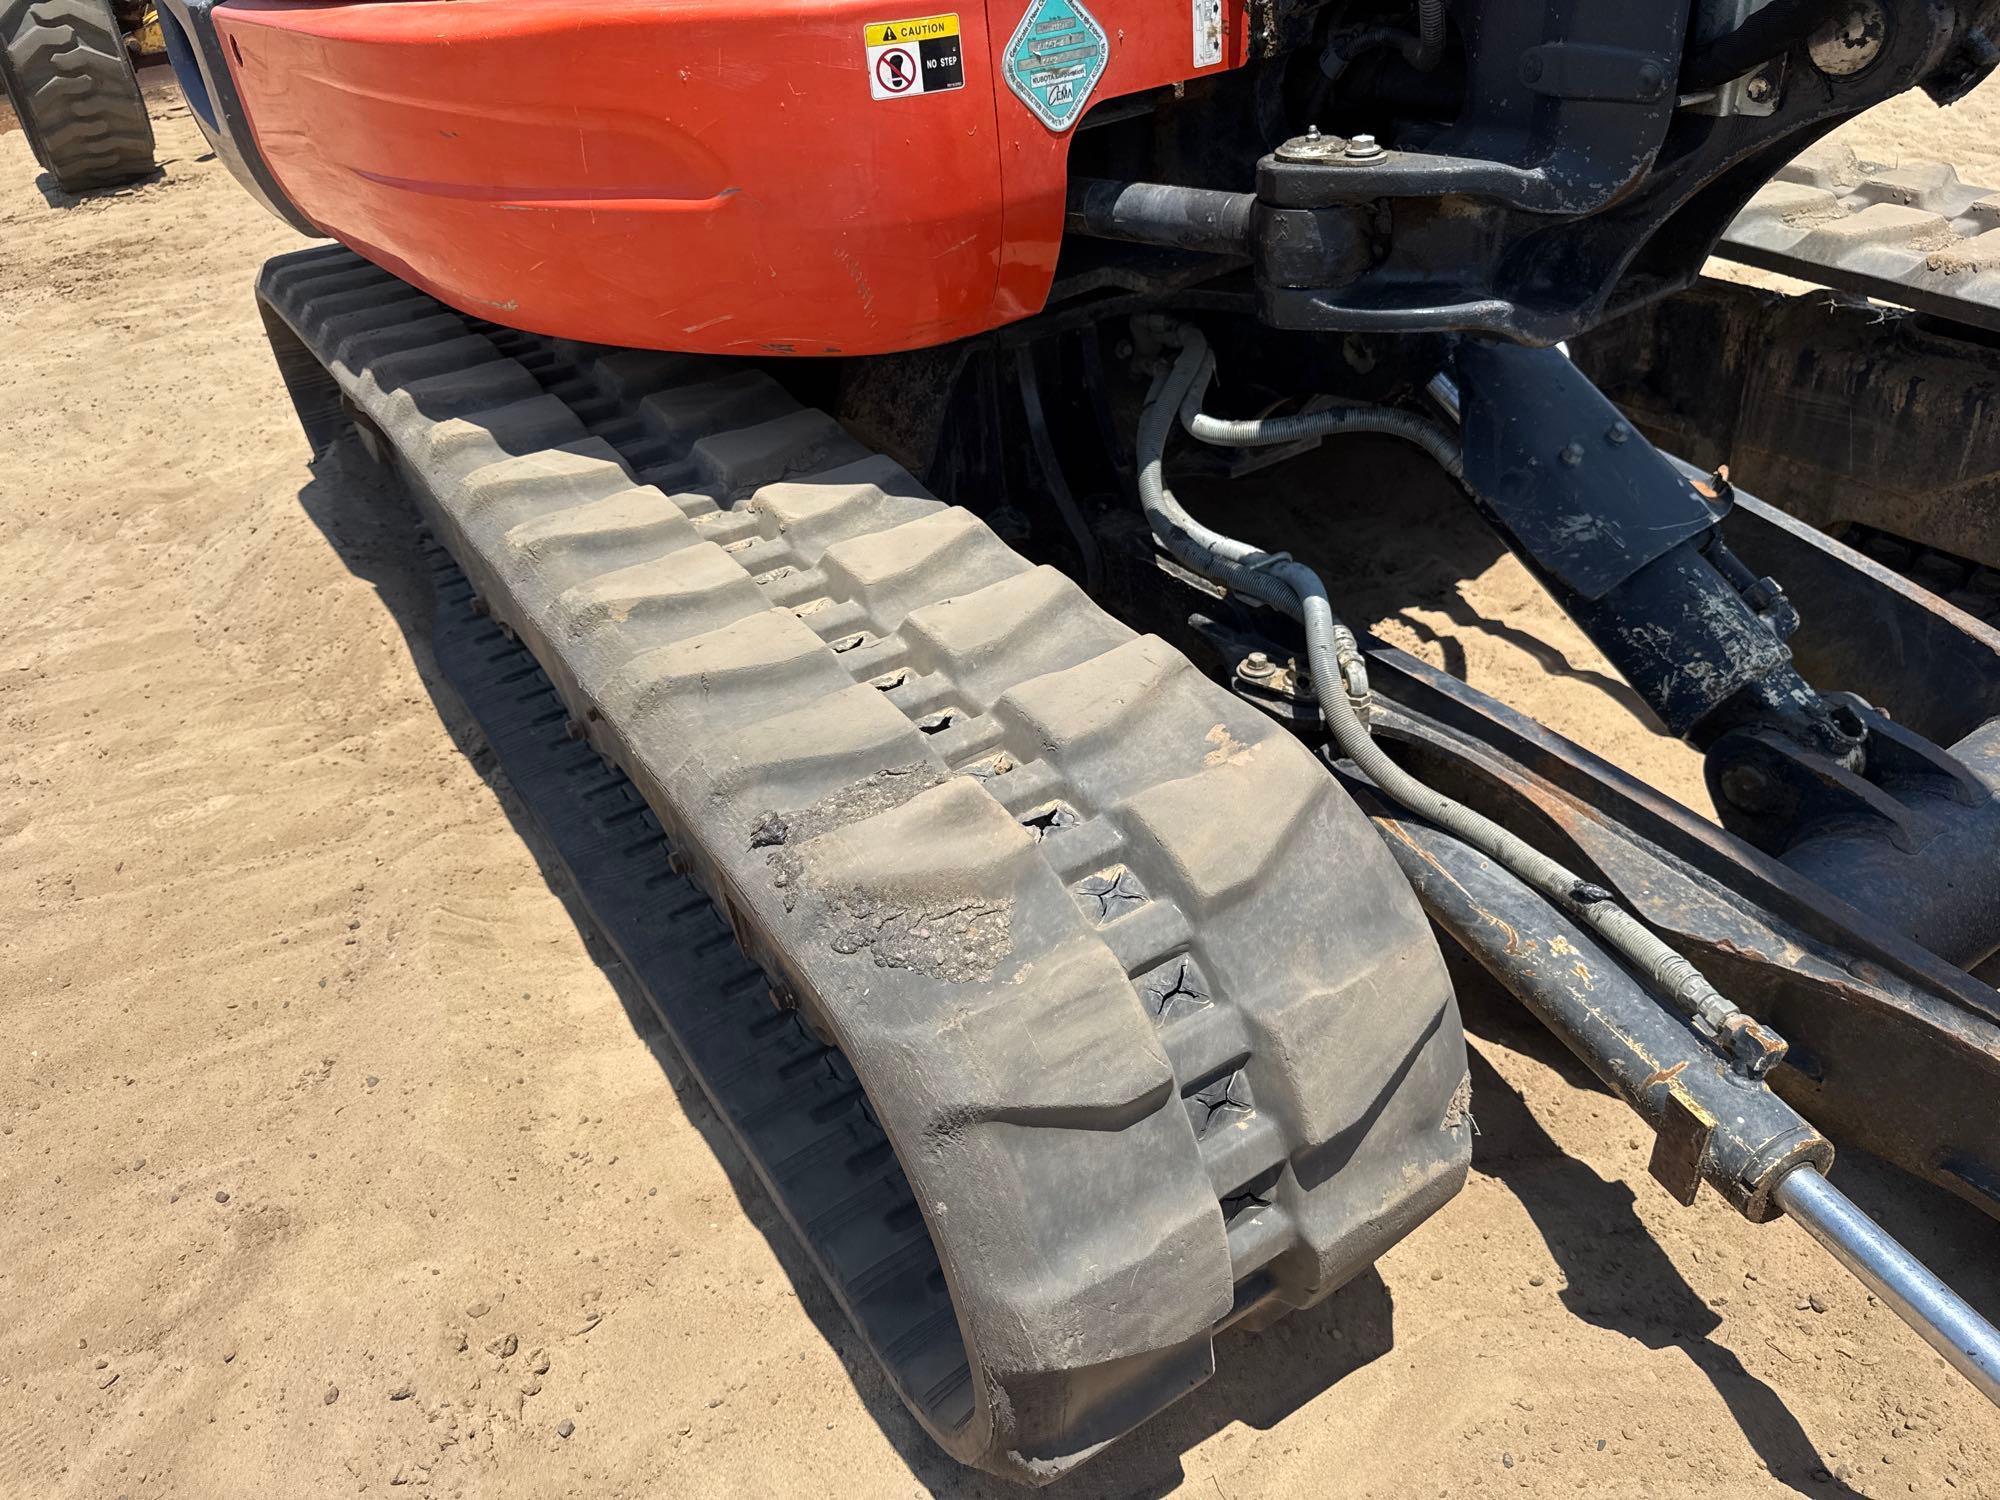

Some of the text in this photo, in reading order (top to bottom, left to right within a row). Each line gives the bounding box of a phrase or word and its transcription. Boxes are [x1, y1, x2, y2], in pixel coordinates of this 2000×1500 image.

[900, 22, 945, 37] CAUTION
[1009, 27, 1029, 57] Certificate
[926, 56, 957, 69] NO STEP
[1032, 74, 1054, 83] KUBOTA
[1048, 85, 1073, 106] CEMA
